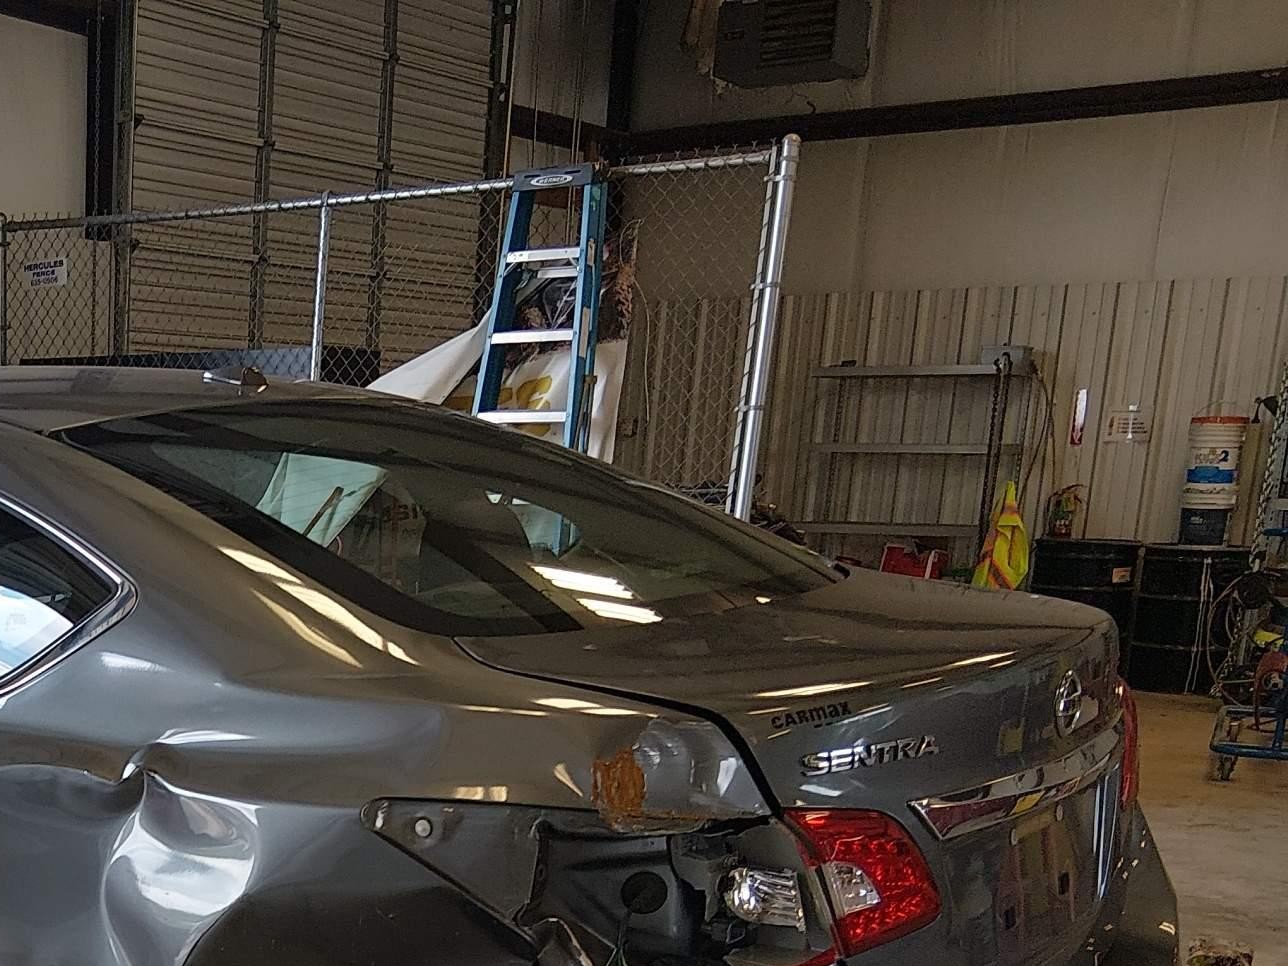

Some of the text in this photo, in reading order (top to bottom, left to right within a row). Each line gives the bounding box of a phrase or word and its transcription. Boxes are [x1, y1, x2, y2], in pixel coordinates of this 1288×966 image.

[24, 260, 64, 272] HERCULES
[32, 269, 56, 278] FENCE
[799, 735, 939, 777] SENTRA
